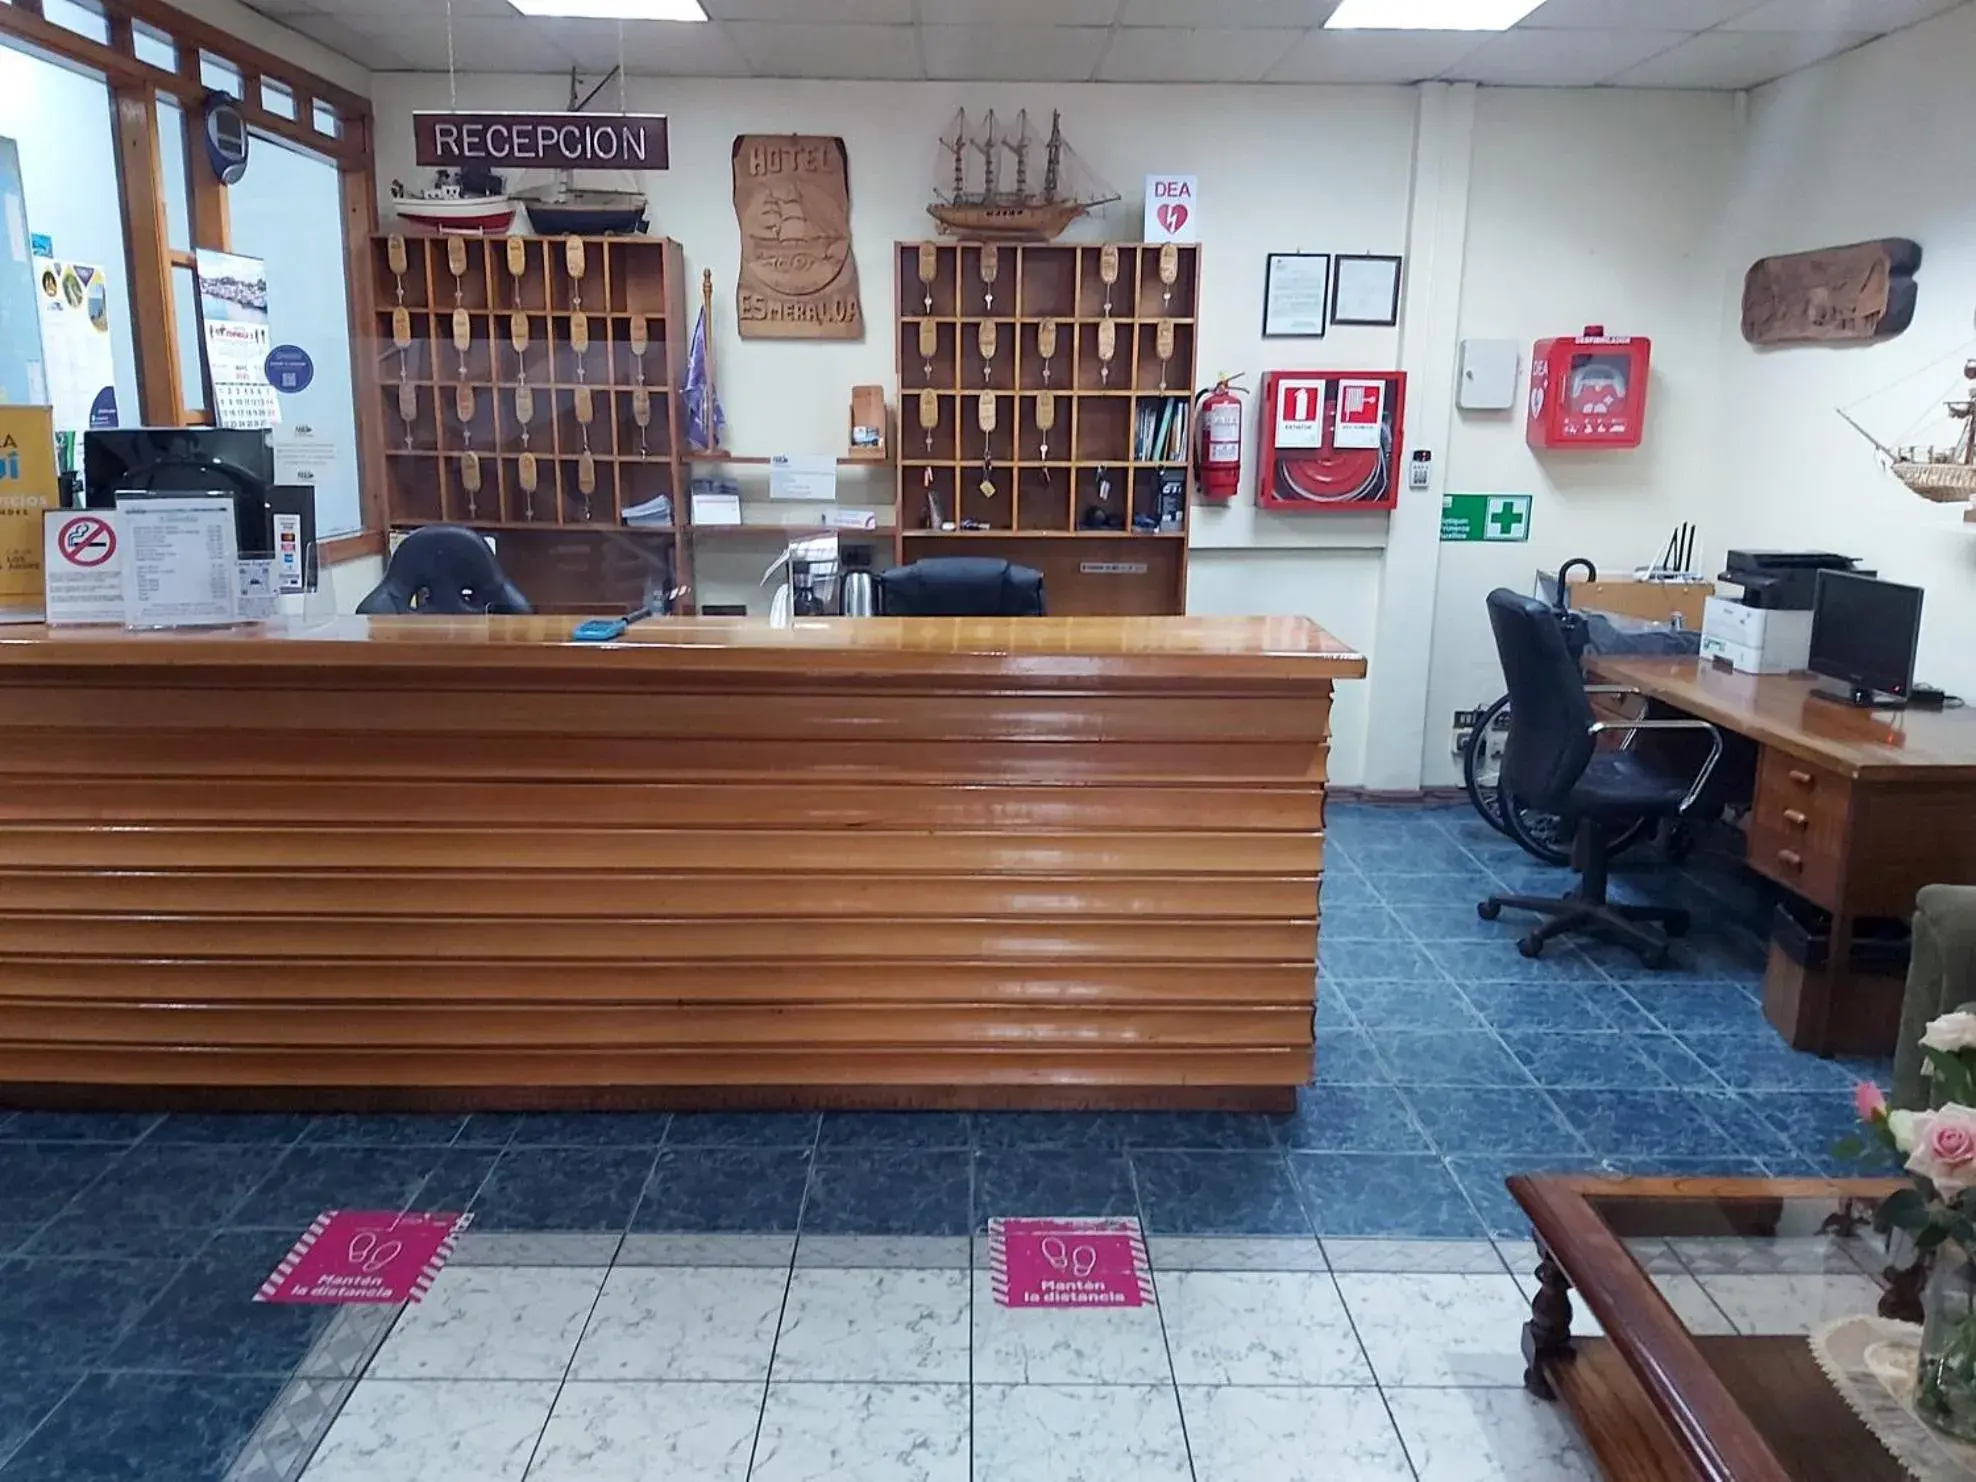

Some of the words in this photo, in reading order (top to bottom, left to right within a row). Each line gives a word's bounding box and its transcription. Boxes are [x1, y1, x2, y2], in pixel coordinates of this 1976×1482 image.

[434, 123, 646, 161] RECEPCION
[748, 145, 837, 177] HOTEL
[1154, 181, 1192, 198] DEA
[740, 294, 859, 326] ESMERALDA
[311, 1285, 393, 1297] distancia
[1043, 1291, 1126, 1302] distancia
